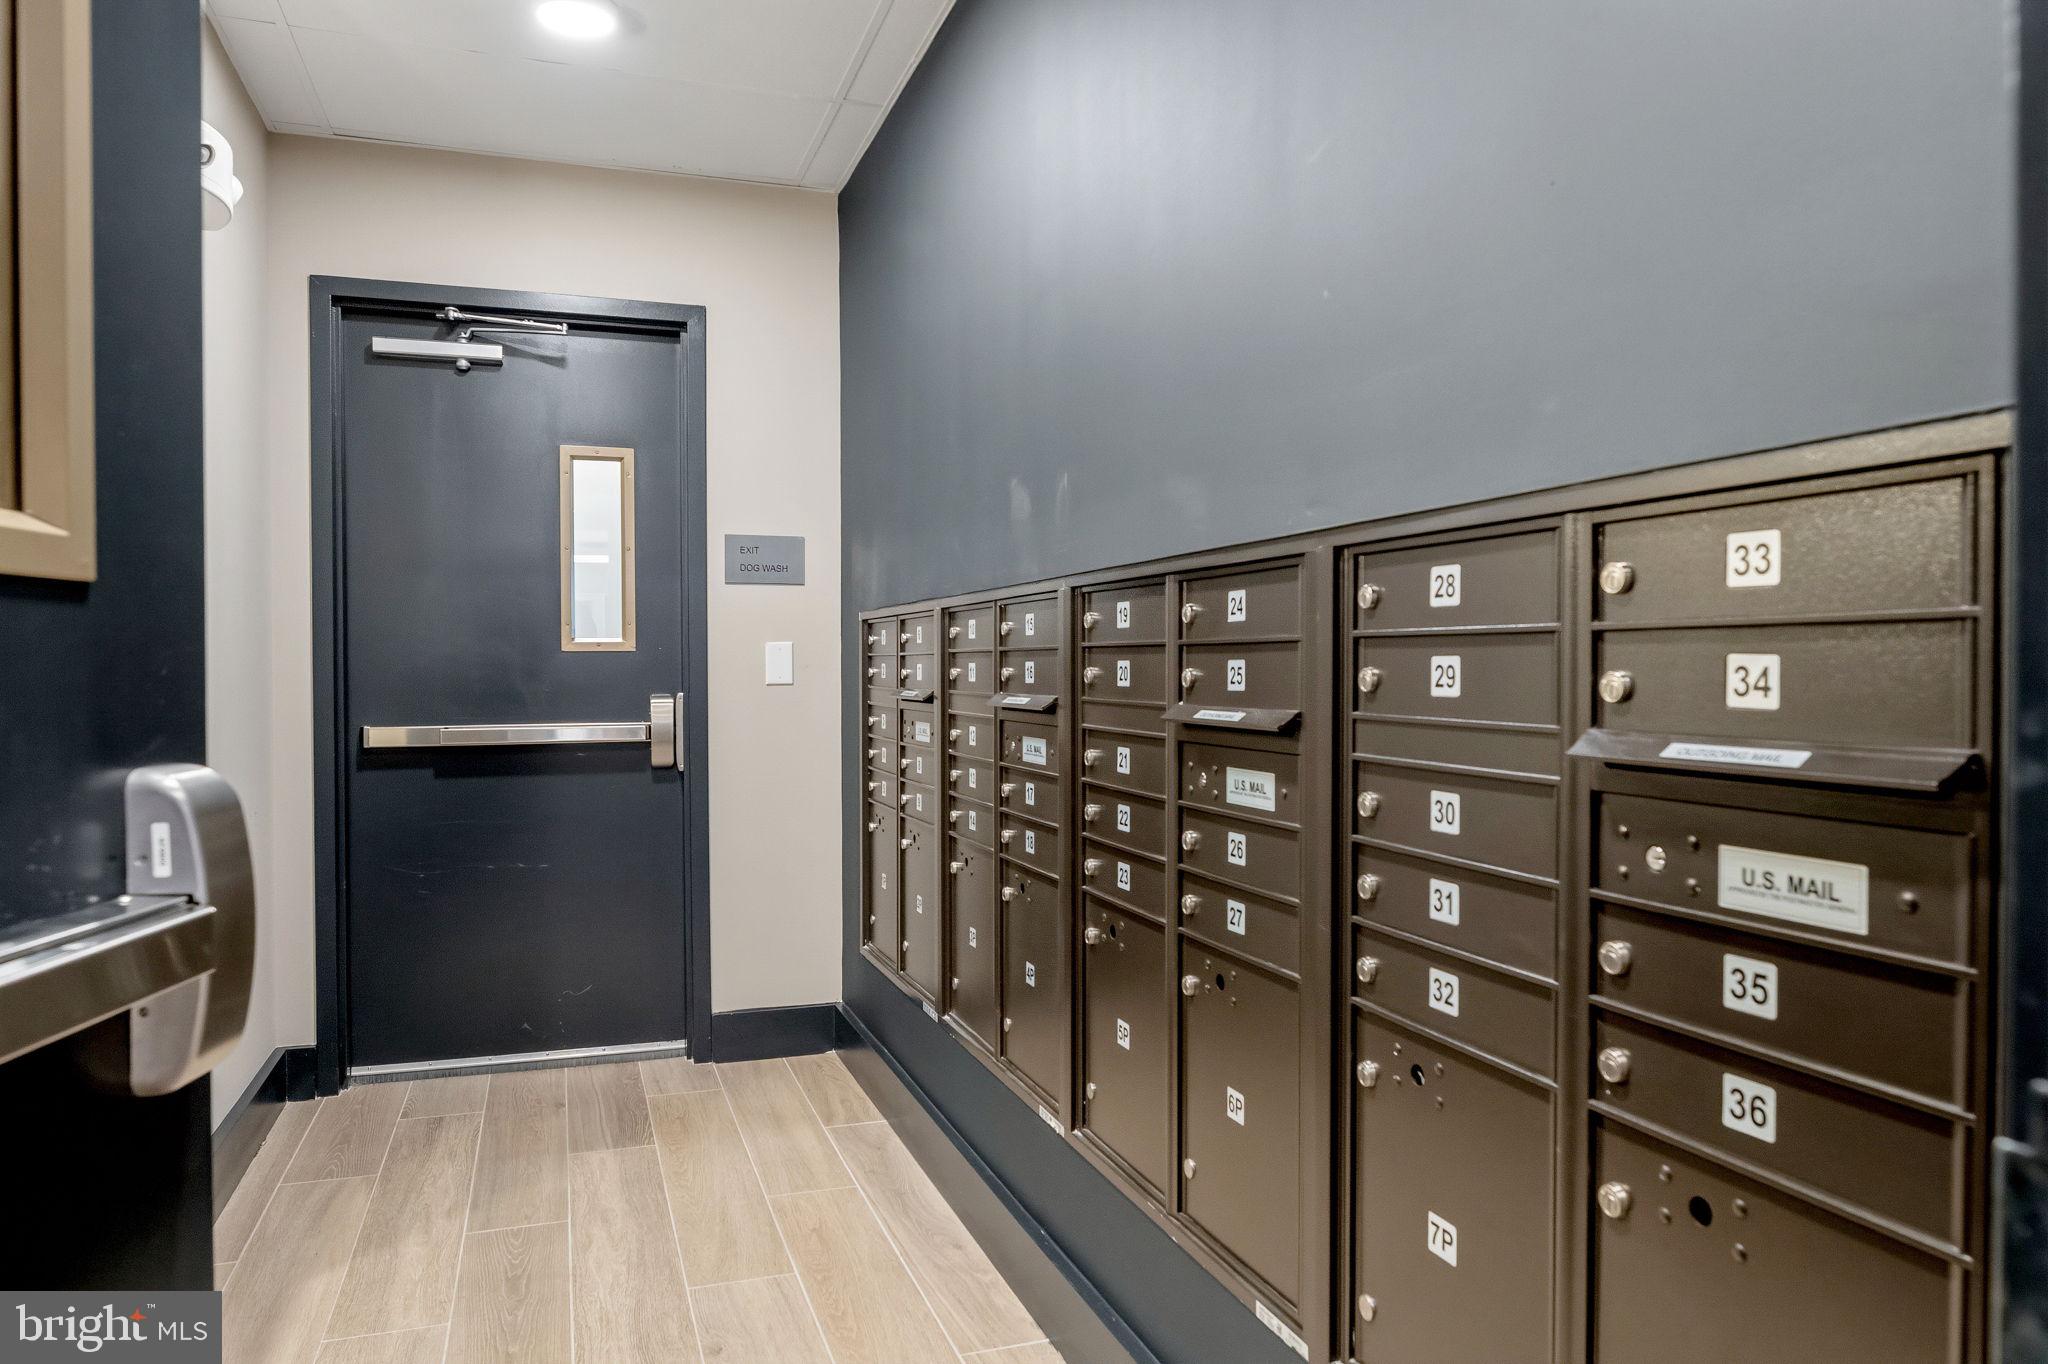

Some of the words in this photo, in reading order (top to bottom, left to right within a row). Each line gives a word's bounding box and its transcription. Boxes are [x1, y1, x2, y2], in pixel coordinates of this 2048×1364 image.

[739, 546, 760, 555] EXIT
[1733, 542, 1772, 577] 33
[739, 563, 760, 572] DOG
[761, 564, 789, 573] WASH
[1434, 573, 1456, 599] 28
[1119, 607, 1128, 623] 19
[1230, 596, 1244, 616] 24
[1026, 618, 1033, 631] 15
[1026, 666, 1033, 679] 16
[1119, 666, 1128, 681] 20
[1230, 666, 1243, 686] 25
[1434, 664, 1456, 689] 29
[1734, 665, 1772, 698] 34
[1119, 752, 1127, 768] 21
[1027, 787, 1033, 800] 17
[1234, 779, 1247, 791] U.S.
[1249, 781, 1267, 795] MAIL
[1119, 810, 1128, 827] 22
[1434, 799, 1455, 826] 30
[1027, 835, 1033, 850] 18
[1230, 838, 1244, 860] 26
[1119, 868, 1128, 885] 23
[1741, 867, 1781, 892] U.S.
[1786, 874, 1841, 903] MAIL
[1433, 888, 1454, 916] 31
[1229, 906, 1243, 928] 27
[1433, 977, 1454, 1007] 32
[1730, 968, 1768, 1006] 35
[1118, 1024, 1128, 1042] 5P
[1228, 1094, 1243, 1116] 6P
[1730, 1088, 1767, 1128] 36
[1430, 1220, 1454, 1252] 7P
